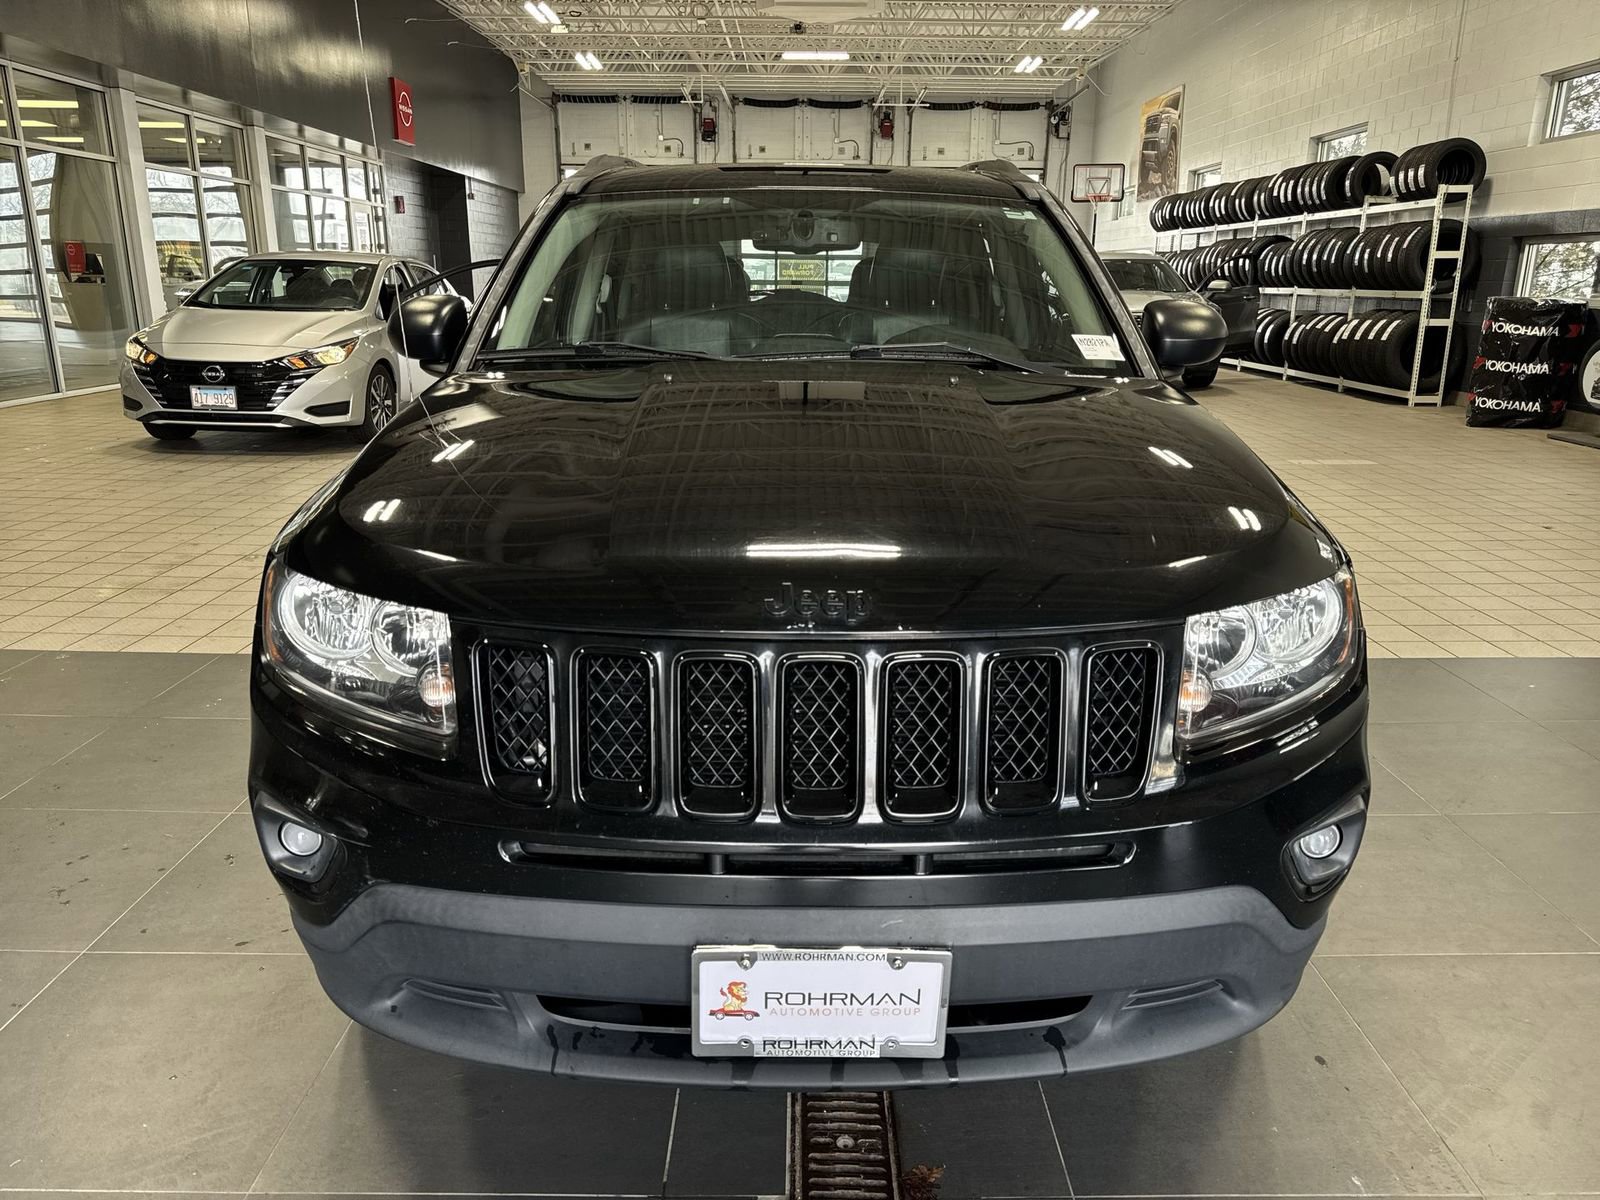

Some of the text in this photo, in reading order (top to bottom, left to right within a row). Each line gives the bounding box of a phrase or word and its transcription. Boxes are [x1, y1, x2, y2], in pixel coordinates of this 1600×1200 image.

[1491, 321, 1559, 337] YOKOHAMA
[1485, 359, 1549, 375] YOKOHAMA
[213, 393, 235, 405] 9129
[1474, 396, 1541, 413] YOKOHAMA
[764, 582, 872, 625] Jeep
[761, 952, 886, 961] WWW.ROHRMAN.COM
[764, 988, 921, 1010] ROHRMAN
[769, 1007, 921, 1017] AUTOMOTIVE GROUP
[762, 1036, 876, 1052] ROHRMAN
[766, 1049, 876, 1057] AUTOMOTIVE GROUP
